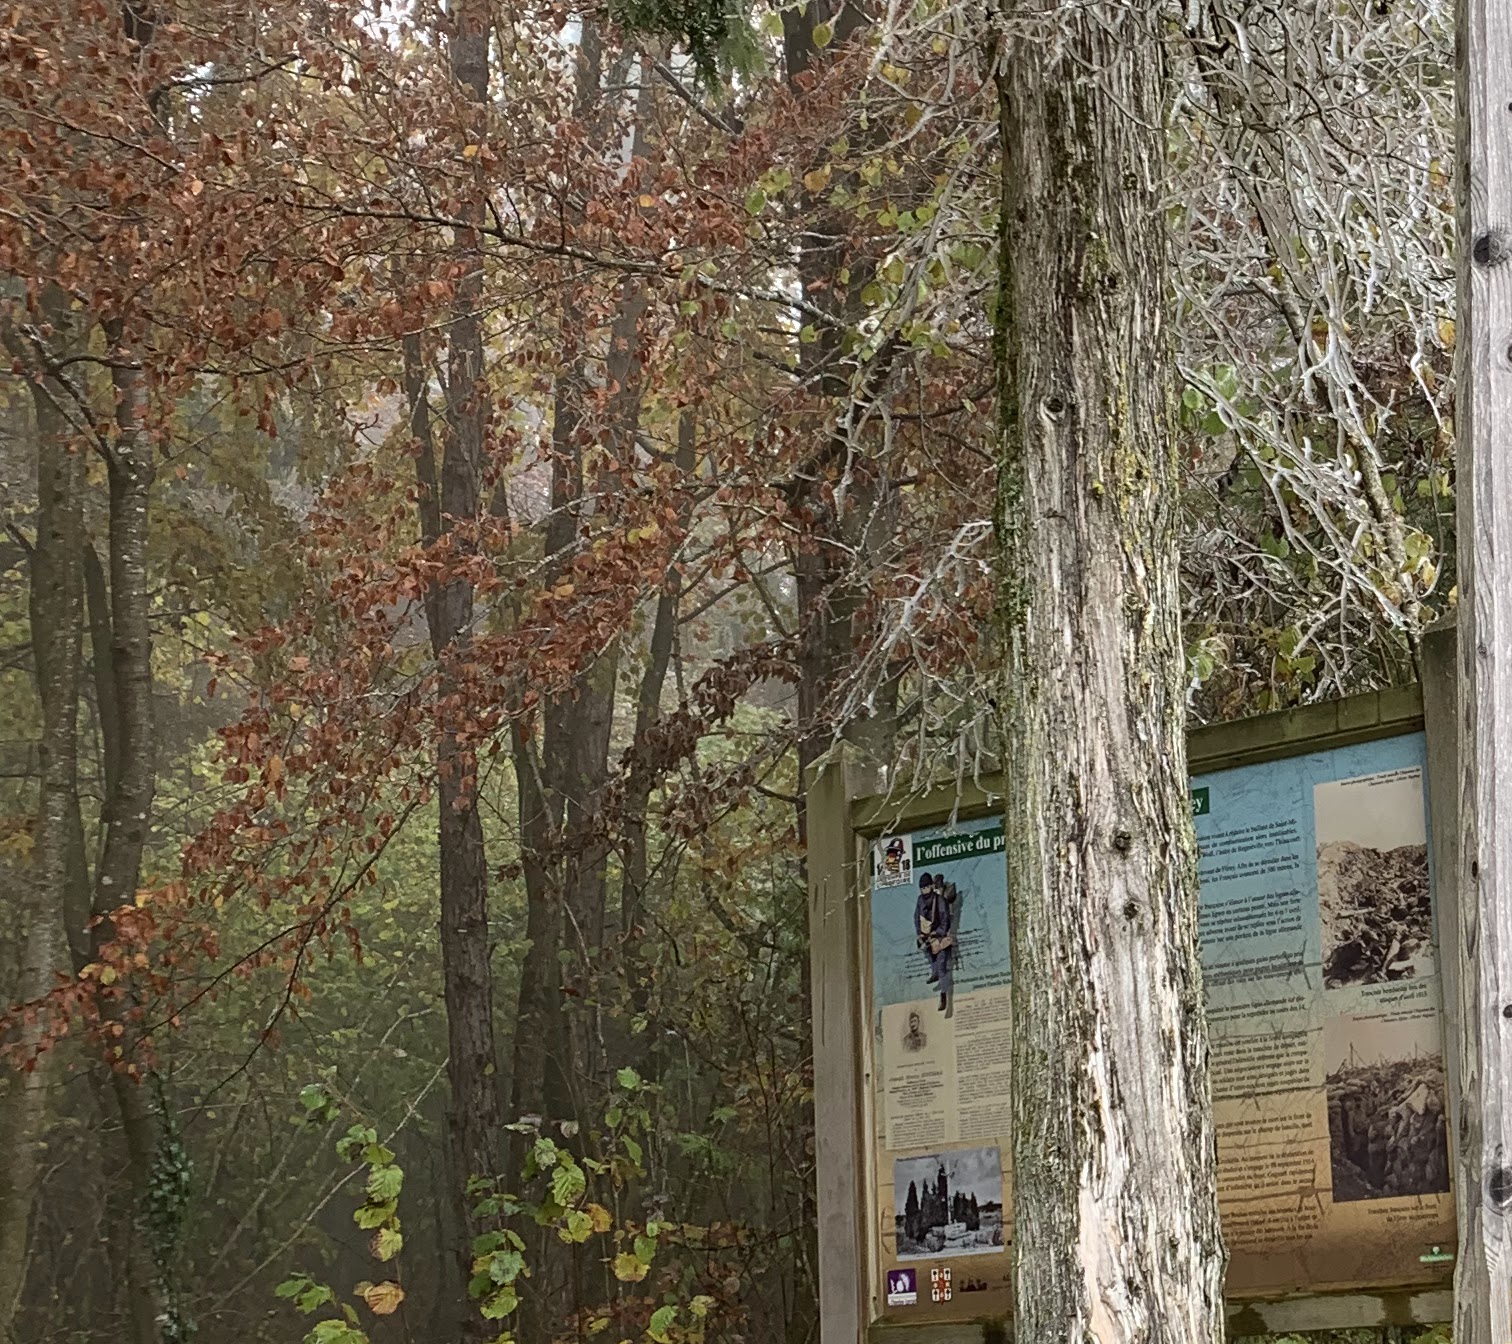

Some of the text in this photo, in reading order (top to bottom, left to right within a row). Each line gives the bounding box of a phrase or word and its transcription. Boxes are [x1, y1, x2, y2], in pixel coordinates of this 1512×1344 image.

[916, 834, 1006, 862] l'offensive du pr
